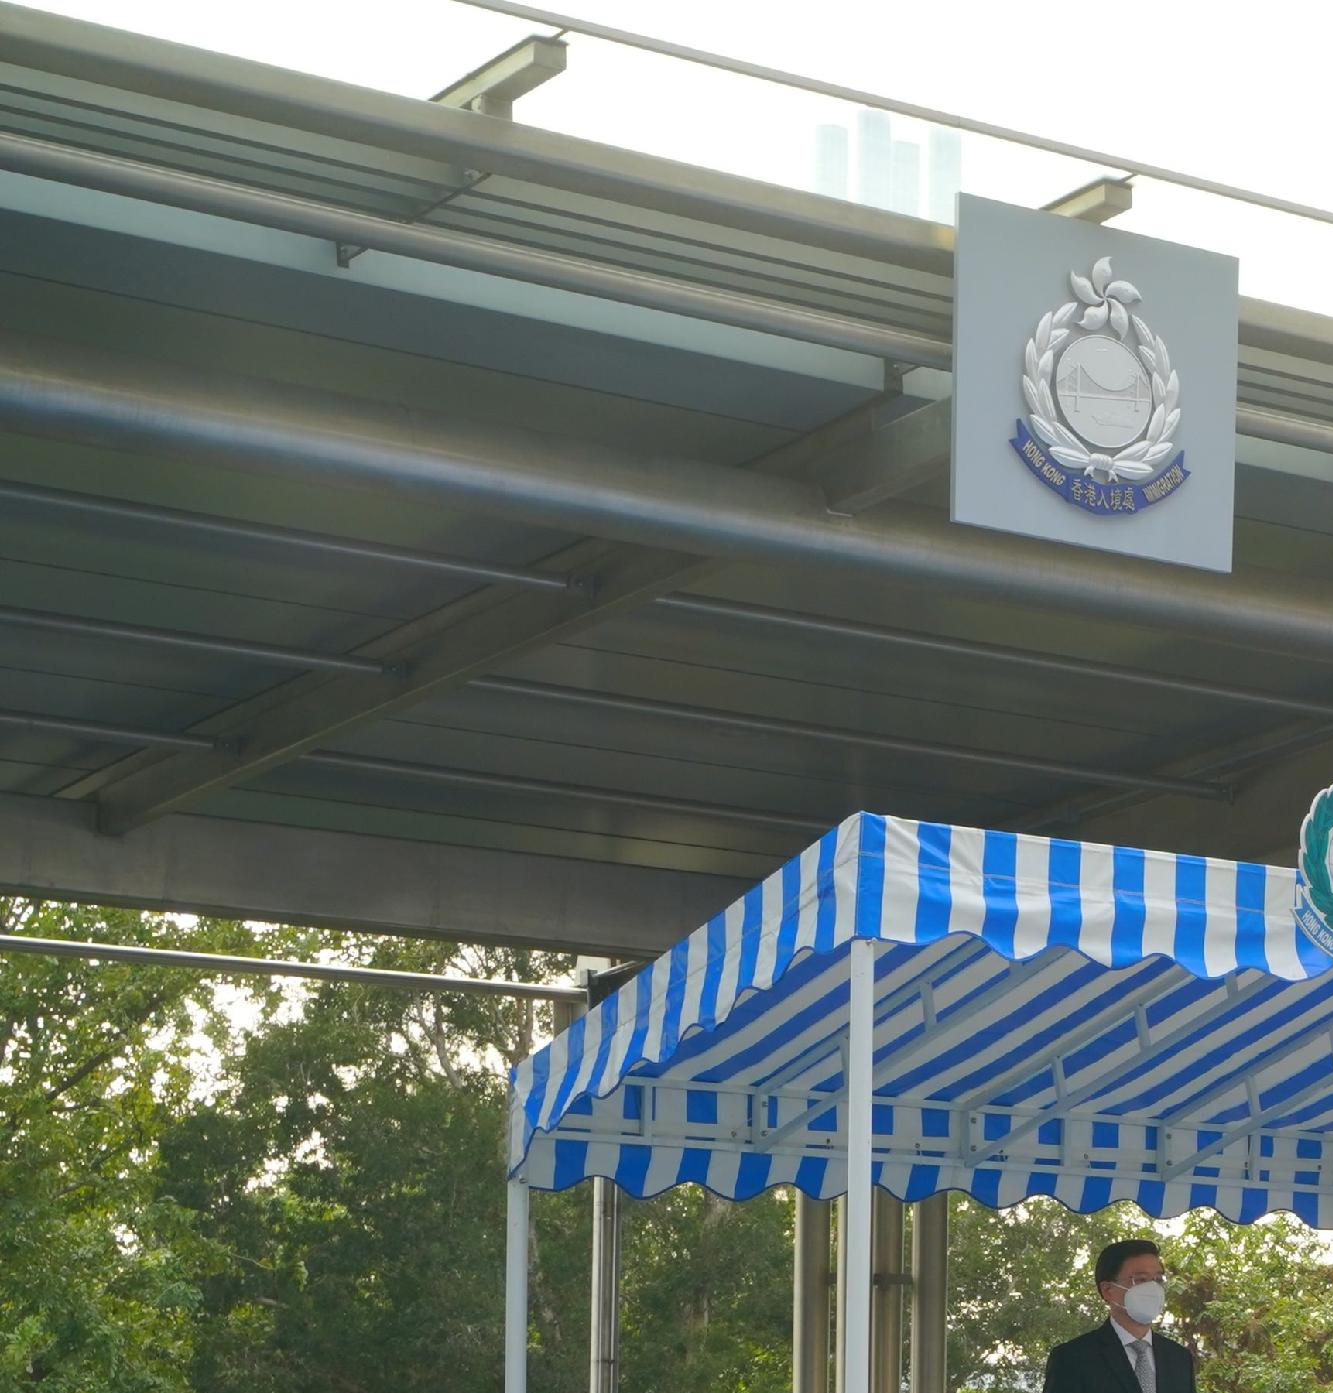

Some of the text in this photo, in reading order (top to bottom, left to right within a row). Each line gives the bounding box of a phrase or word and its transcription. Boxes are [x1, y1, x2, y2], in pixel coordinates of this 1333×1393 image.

[1022, 439, 1067, 486] HONG KONG
[1071, 478, 1136, 512] 香港入境處
[1302, 911, 1319, 935] HONG
